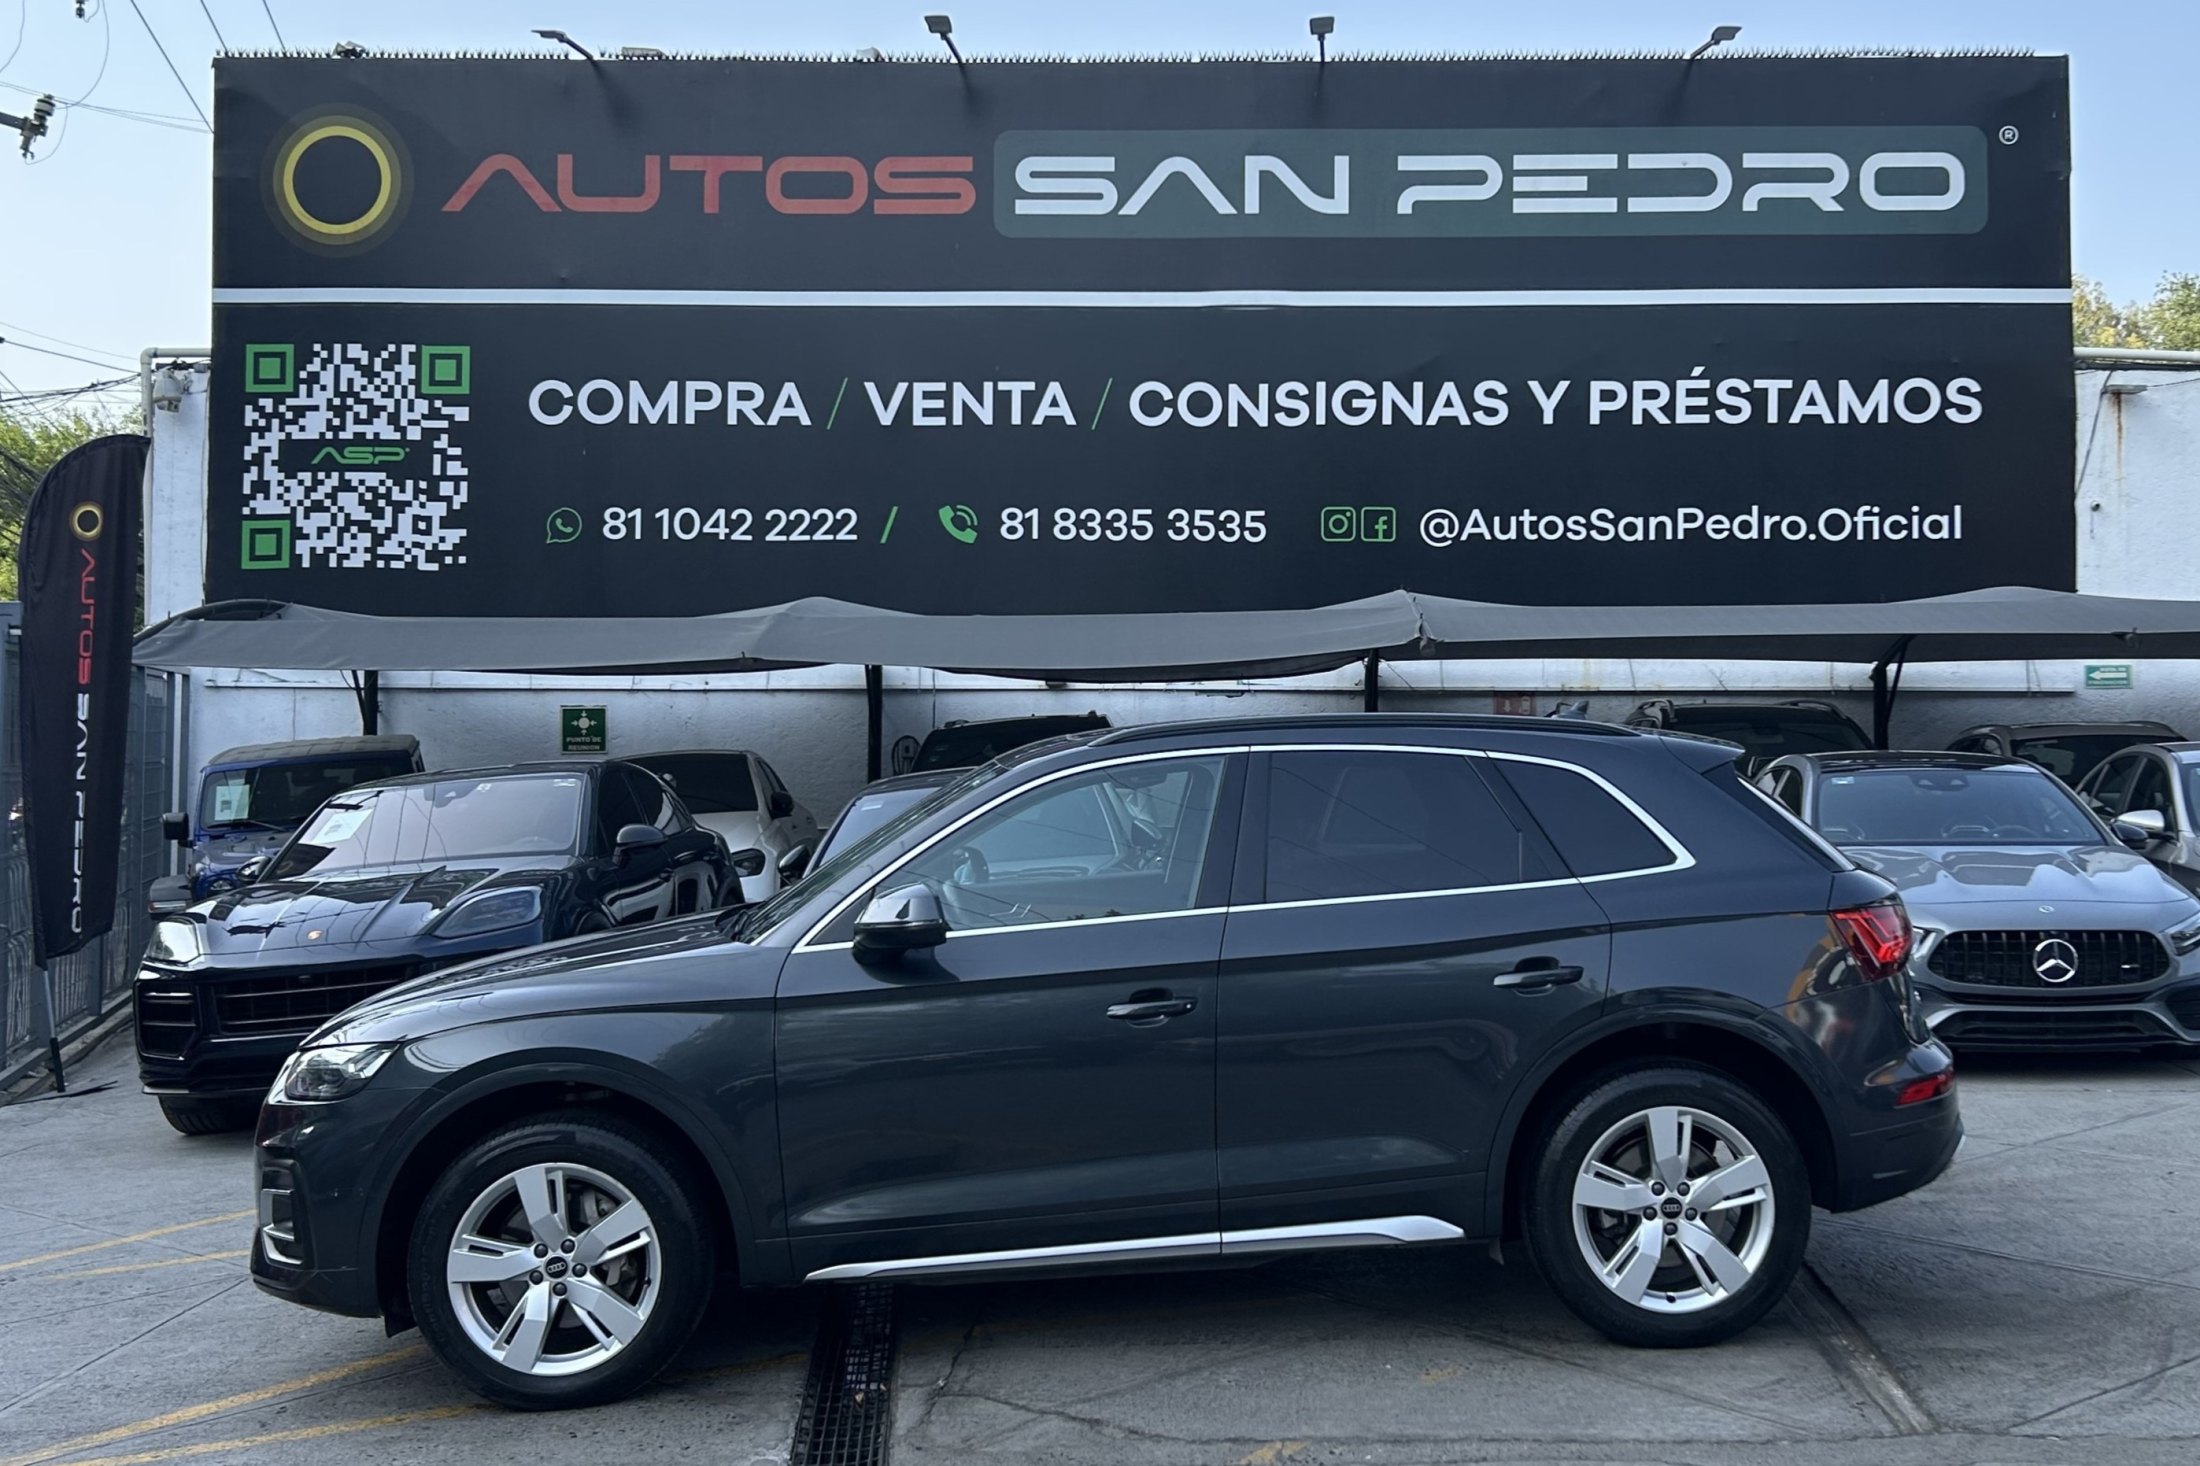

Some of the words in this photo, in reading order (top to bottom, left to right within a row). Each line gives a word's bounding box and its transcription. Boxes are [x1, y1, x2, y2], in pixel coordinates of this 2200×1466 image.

[443, 154, 976, 215] AUTOS
[1014, 155, 1350, 216] SAN
[1396, 151, 1966, 215] PEDRO
[528, 378, 813, 426] COMPRA
[863, 380, 1078, 427] VENTA
[1129, 379, 1509, 428] CONSIGNAS
[1527, 379, 1572, 425] Y
[1589, 365, 1983, 426] PRÉSTAMOS
[311, 446, 405, 465] ASP
[602, 506, 642, 540] 81
[655, 507, 753, 541] 1042
[764, 508, 858, 542] 2222
[999, 506, 1039, 541] 81
[1052, 507, 1154, 542] 8335
[1166, 508, 1267, 543] 3535
[1419, 504, 1962, 548] @AutosSanPedro.Oficial
[79, 548, 95, 684] AUTOS
[76, 693, 89, 780] SAN
